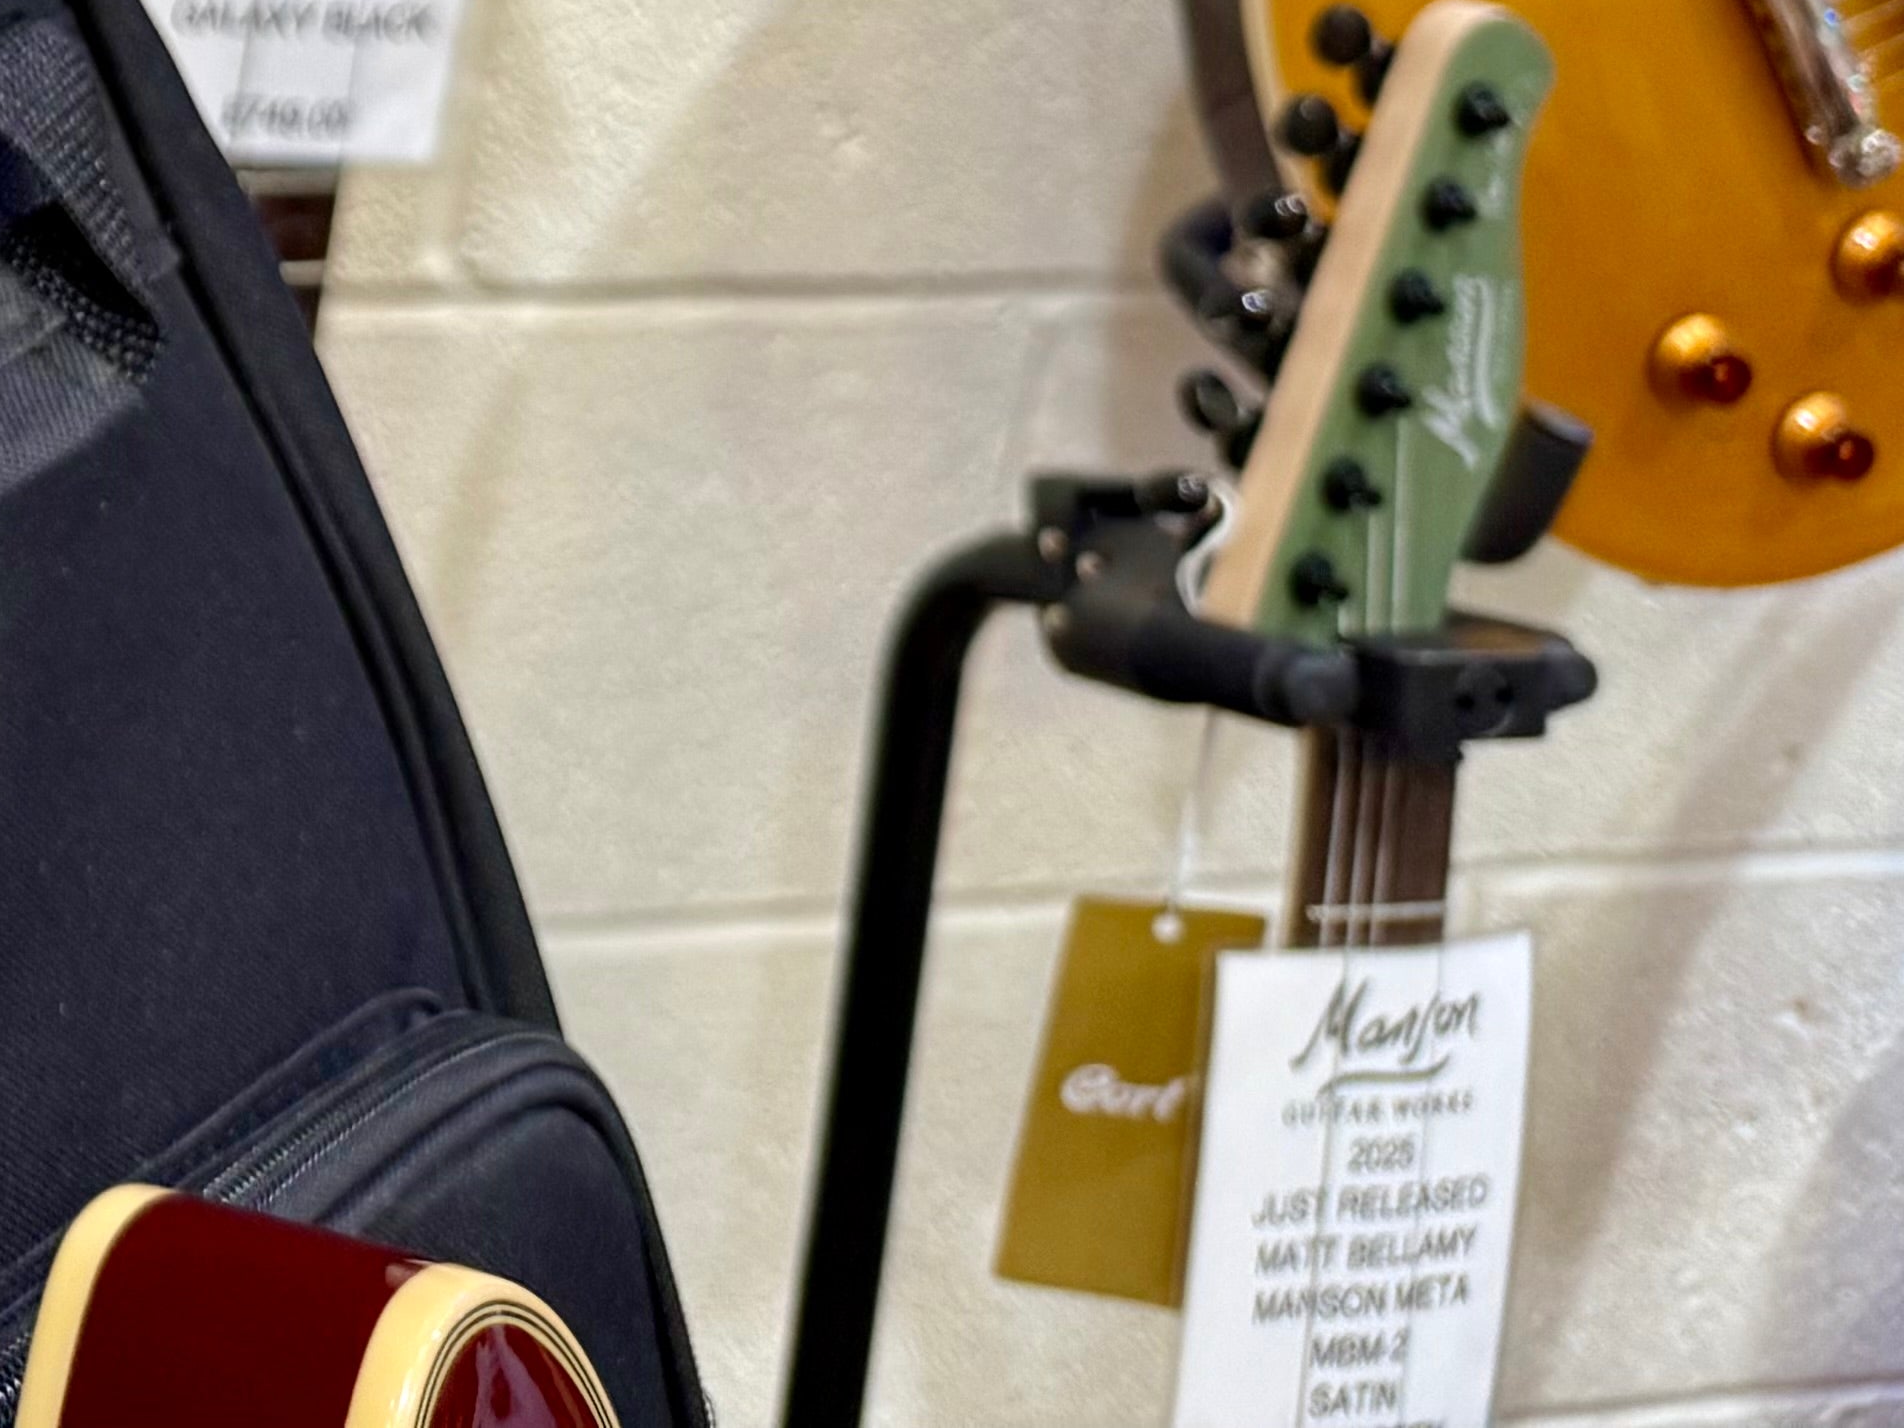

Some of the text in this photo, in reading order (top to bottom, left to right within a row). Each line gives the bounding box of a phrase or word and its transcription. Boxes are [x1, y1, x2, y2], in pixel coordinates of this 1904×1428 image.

[323, 1, 436, 43] BLACK
[1289, 975, 1480, 1072] Manson
[1346, 1135, 1416, 1173] 2025
[1252, 1172, 1490, 1230] JUST RELEASED
[1253, 1223, 1479, 1276] MATT BELLAMY
[1251, 1272, 1471, 1326] MANSON META
[1307, 1378, 1397, 1419] SATIN
